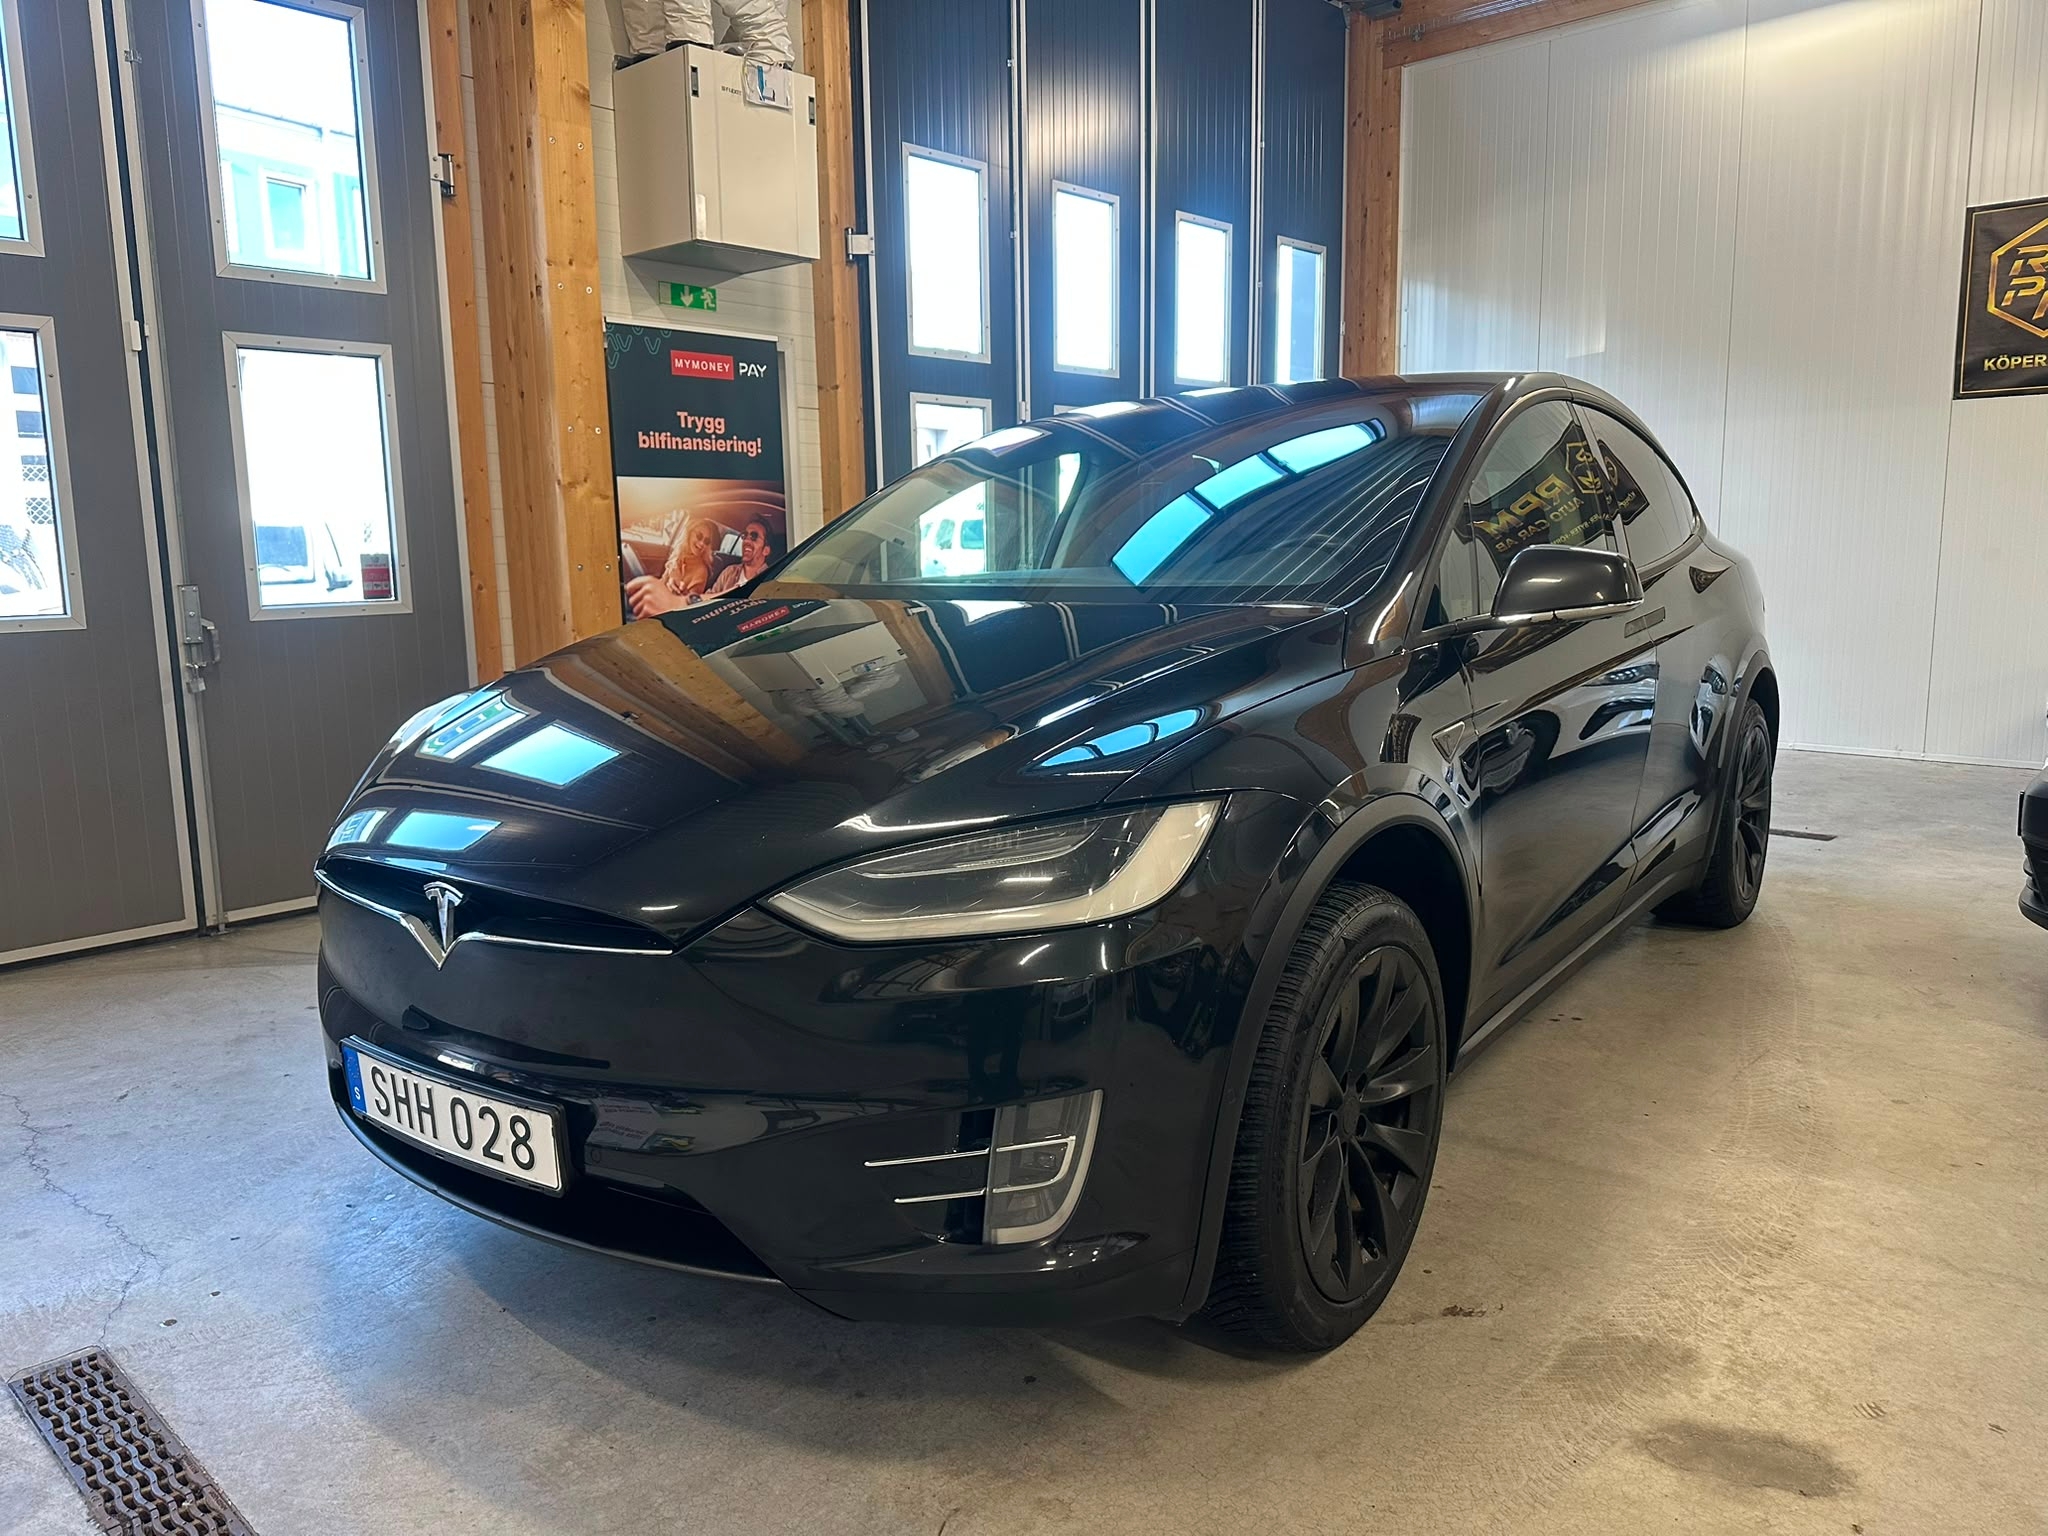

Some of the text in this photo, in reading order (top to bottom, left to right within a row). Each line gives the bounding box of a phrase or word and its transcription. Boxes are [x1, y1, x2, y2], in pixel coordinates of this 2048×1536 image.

[674, 358, 767, 378] MYMONEY PAY
[1983, 354, 2048, 371] KÖPER
[676, 411, 726, 434] Trygg
[638, 431, 762, 457] bilfinansiering!
[354, 1086, 361, 1100] S
[370, 1065, 439, 1140] SHH
[449, 1096, 535, 1171] 028
